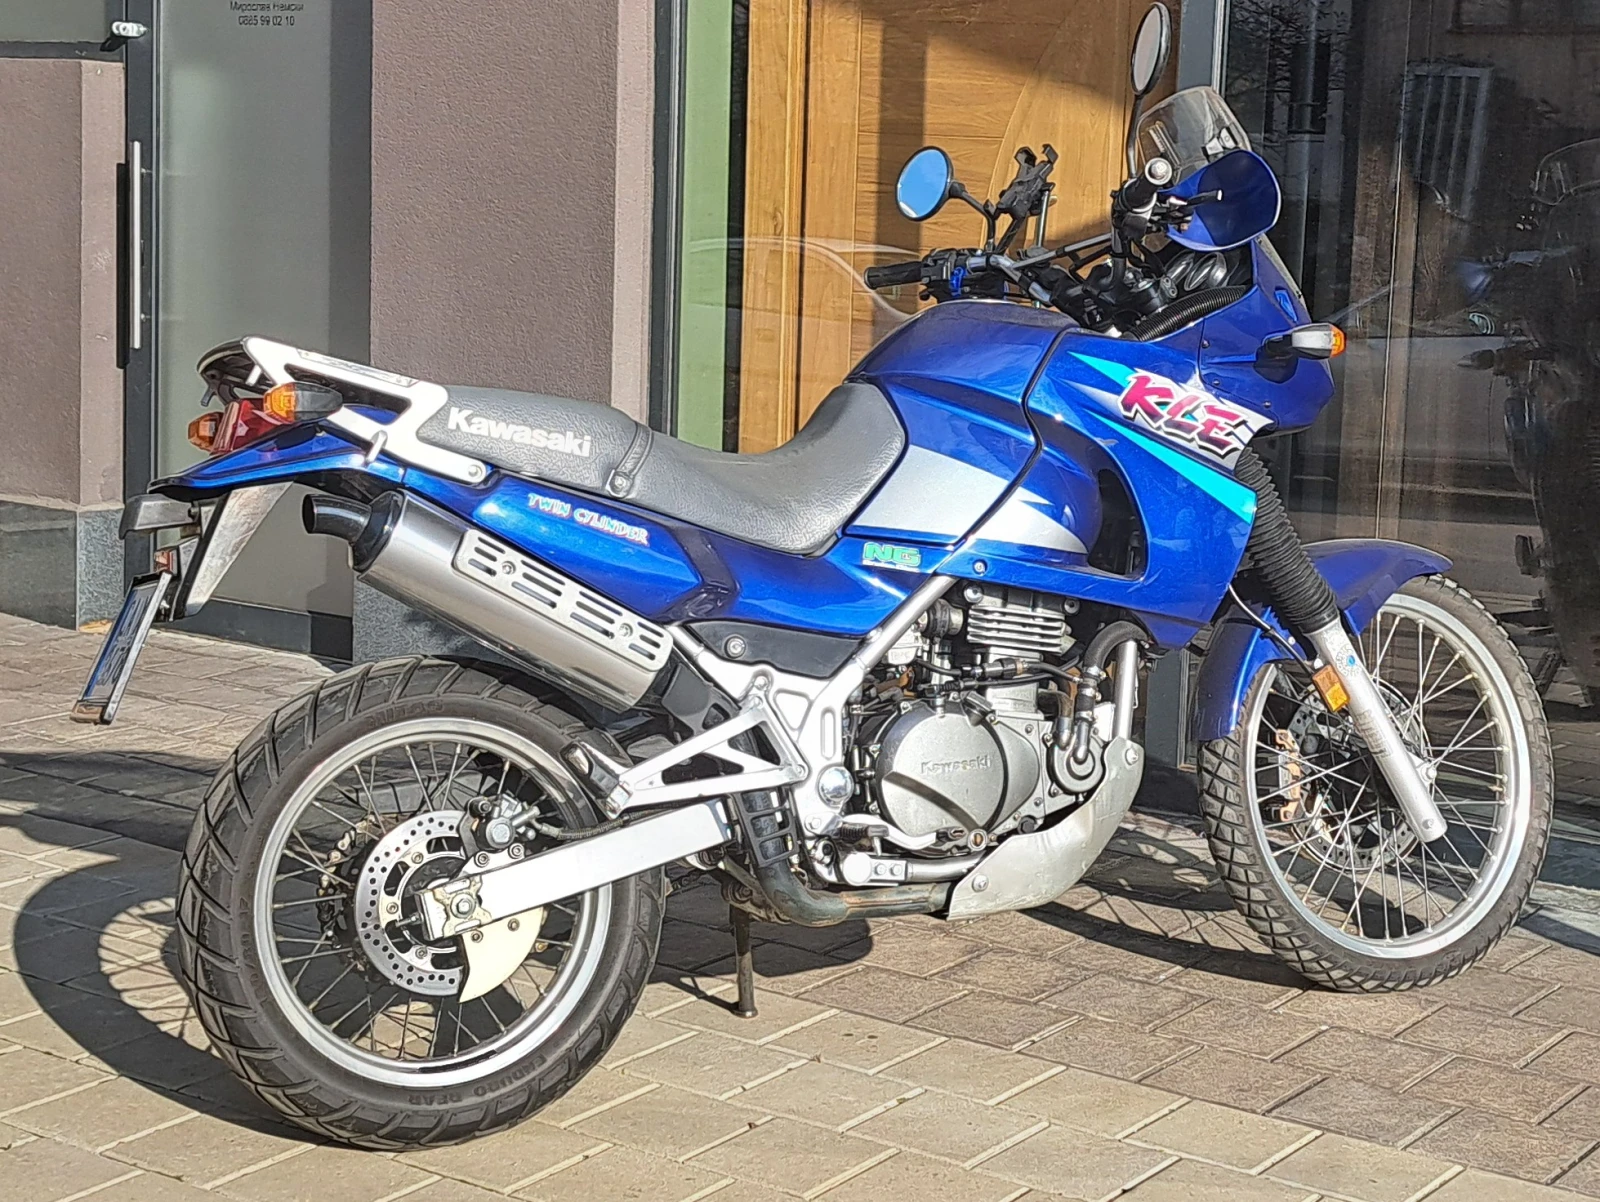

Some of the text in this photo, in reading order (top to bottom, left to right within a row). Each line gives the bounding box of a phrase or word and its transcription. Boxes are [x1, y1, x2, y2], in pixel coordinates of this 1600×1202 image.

[272, 15, 282, 26] 02
[285, 15, 295, 26] 10
[448, 407, 592, 457] Kawasaki
[1119, 375, 1246, 457] KLE
[528, 493, 650, 546] TWIN CYLINDER
[862, 542, 921, 567] NG
[921, 754, 991, 774] Kawasaki
[408, 1053, 548, 1106] ENDURO REAR
